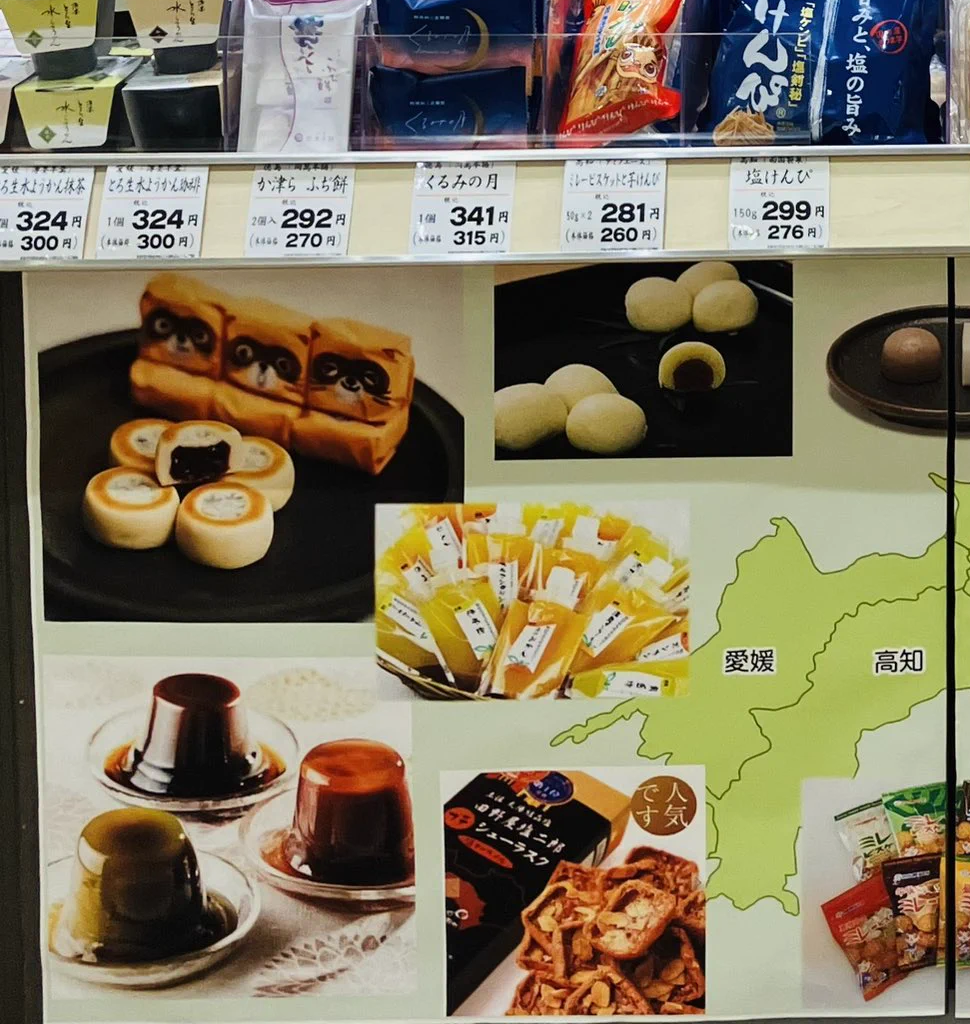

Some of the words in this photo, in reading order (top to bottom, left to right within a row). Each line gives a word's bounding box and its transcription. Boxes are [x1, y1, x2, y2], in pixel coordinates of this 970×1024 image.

[424, 173, 499, 191] くるみの月
[746, 169, 813, 185] 塩けんぴ
[733, 208, 758, 220] 150g
[724, 648, 776, 674] 愛媛
[874, 648, 925, 674] 高知
[475, 822, 551, 867] シューラスク
